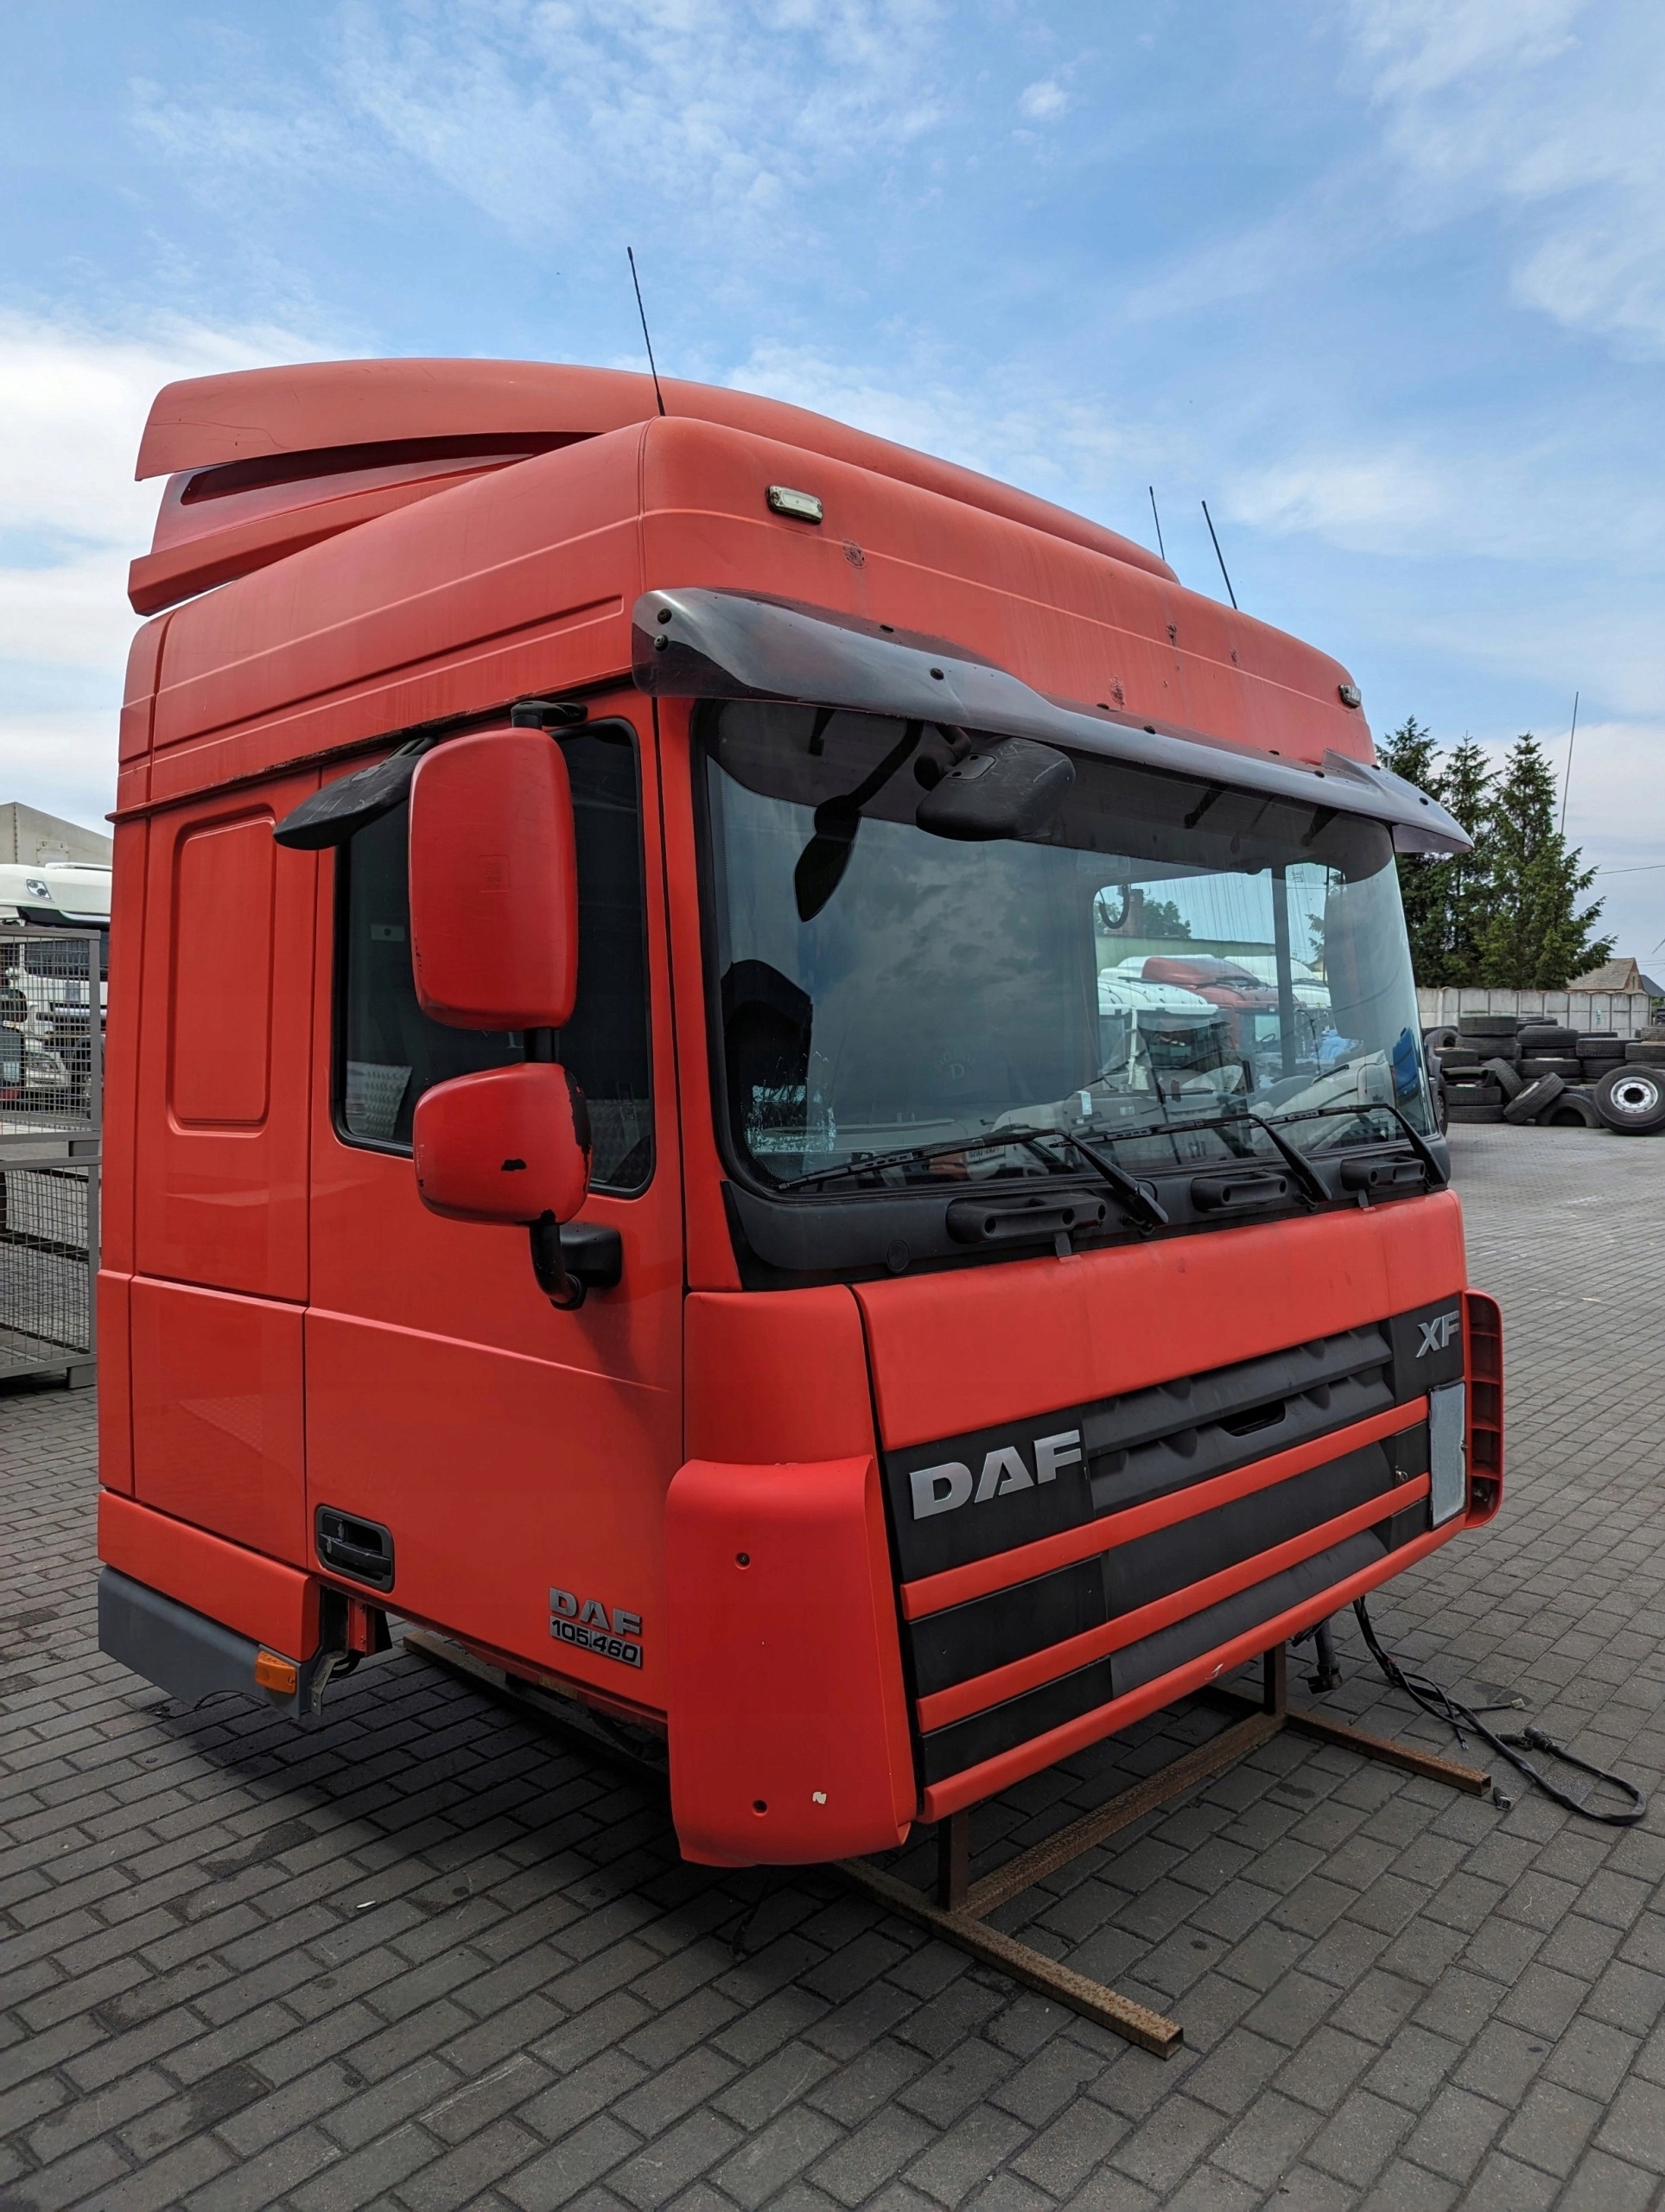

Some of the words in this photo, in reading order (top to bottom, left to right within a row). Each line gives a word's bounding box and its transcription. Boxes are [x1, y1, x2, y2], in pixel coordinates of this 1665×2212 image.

[1416, 1310, 1459, 1358] XF
[910, 1429, 1082, 1520] DAF
[550, 1587, 641, 1635] DAF
[552, 1619, 638, 1662] 105.460
